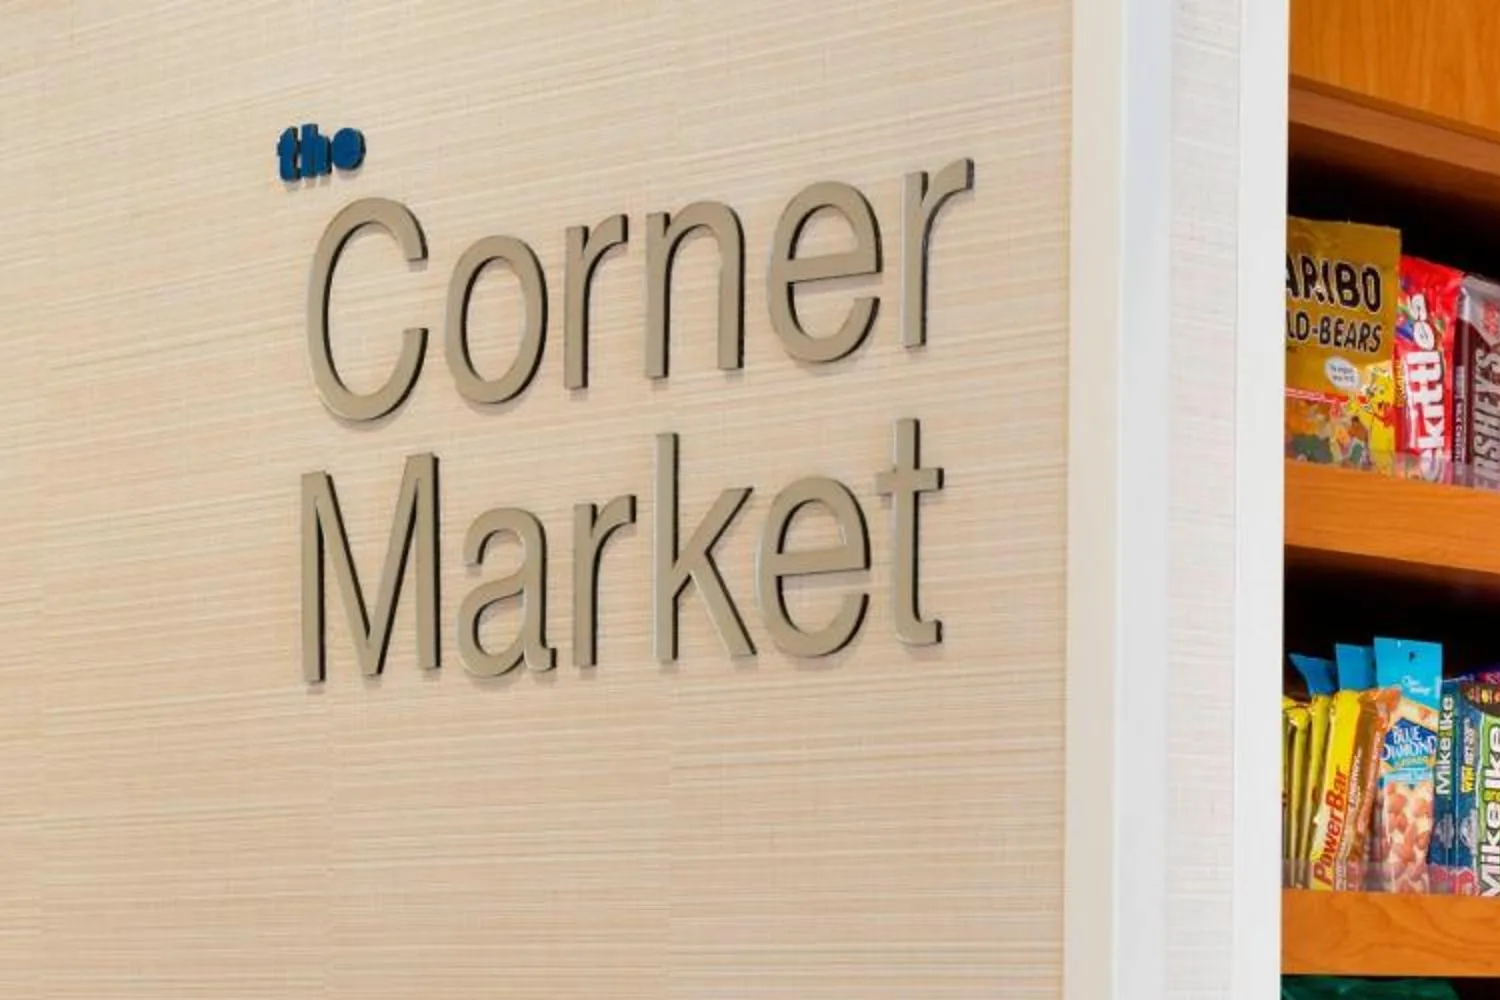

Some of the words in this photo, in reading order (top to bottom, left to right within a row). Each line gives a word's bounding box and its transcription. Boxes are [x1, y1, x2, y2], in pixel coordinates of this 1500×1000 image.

[277, 123, 367, 182] the
[306, 157, 975, 421] Corner
[1286, 253, 1383, 313] ARIBO
[300, 418, 945, 685] Market
